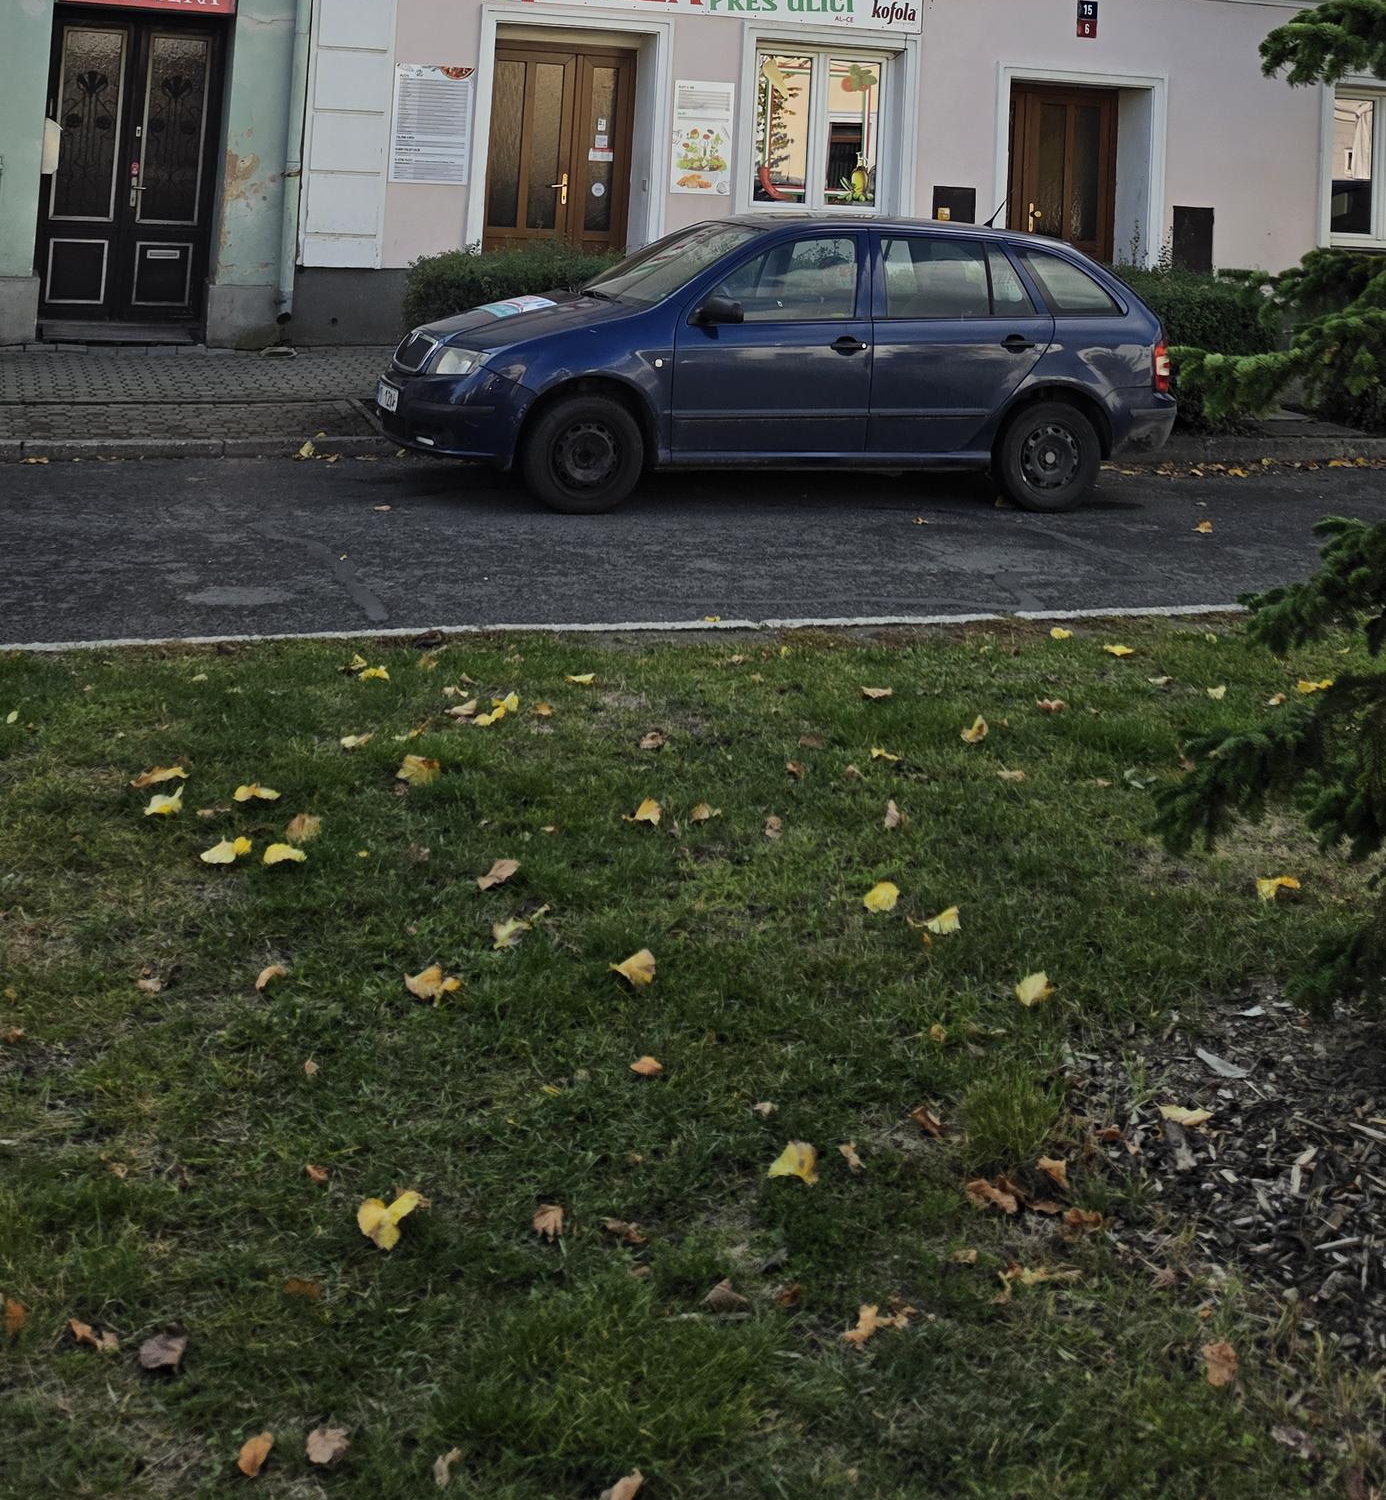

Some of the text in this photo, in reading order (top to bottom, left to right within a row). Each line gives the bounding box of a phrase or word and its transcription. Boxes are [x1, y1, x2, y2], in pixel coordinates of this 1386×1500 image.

[871, 0, 917, 25] kofola
[1083, 4, 1093, 16] 15
[1084, 23, 1090, 35] 6
